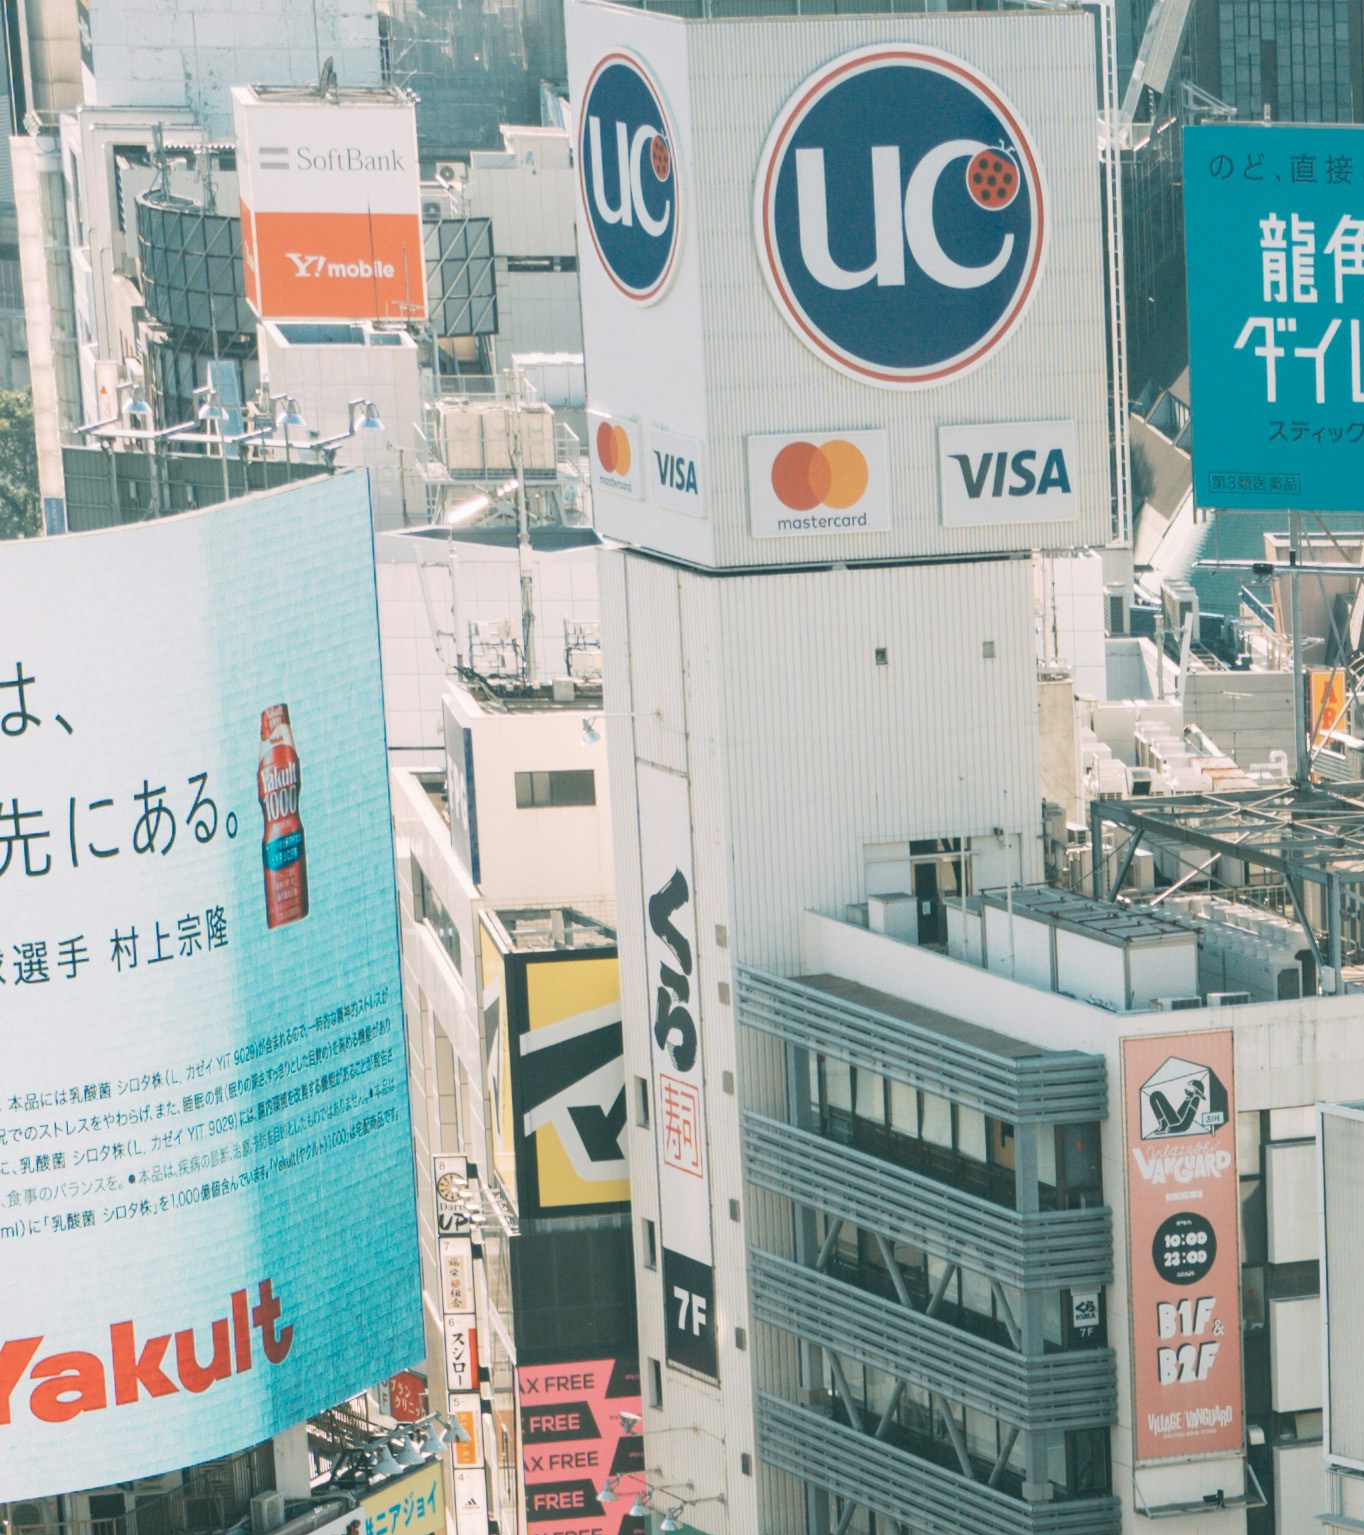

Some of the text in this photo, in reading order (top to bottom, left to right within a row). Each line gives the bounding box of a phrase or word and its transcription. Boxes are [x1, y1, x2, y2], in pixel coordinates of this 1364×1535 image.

[297, 145, 406, 174] SoftBank
[285, 252, 396, 280] Y!mobile
[652, 450, 699, 496] VISA
[947, 447, 1072, 499] VISA
[777, 513, 868, 531] mastercard
[1133, 1147, 1231, 1185] VANGUARD
[674, 1287, 707, 1337] 7F
[1157, 1297, 1217, 1340] B1F
[1158, 1342, 1220, 1386] B2F
[545, 1373, 594, 1393] FREE
[530, 1412, 580, 1433] FREE
[1147, 1408, 1182, 1435] VILLAGE
[1185, 1405, 1233, 1430] VANGUARD
[550, 1450, 599, 1470] FREE
[534, 1490, 584, 1511] FREE
